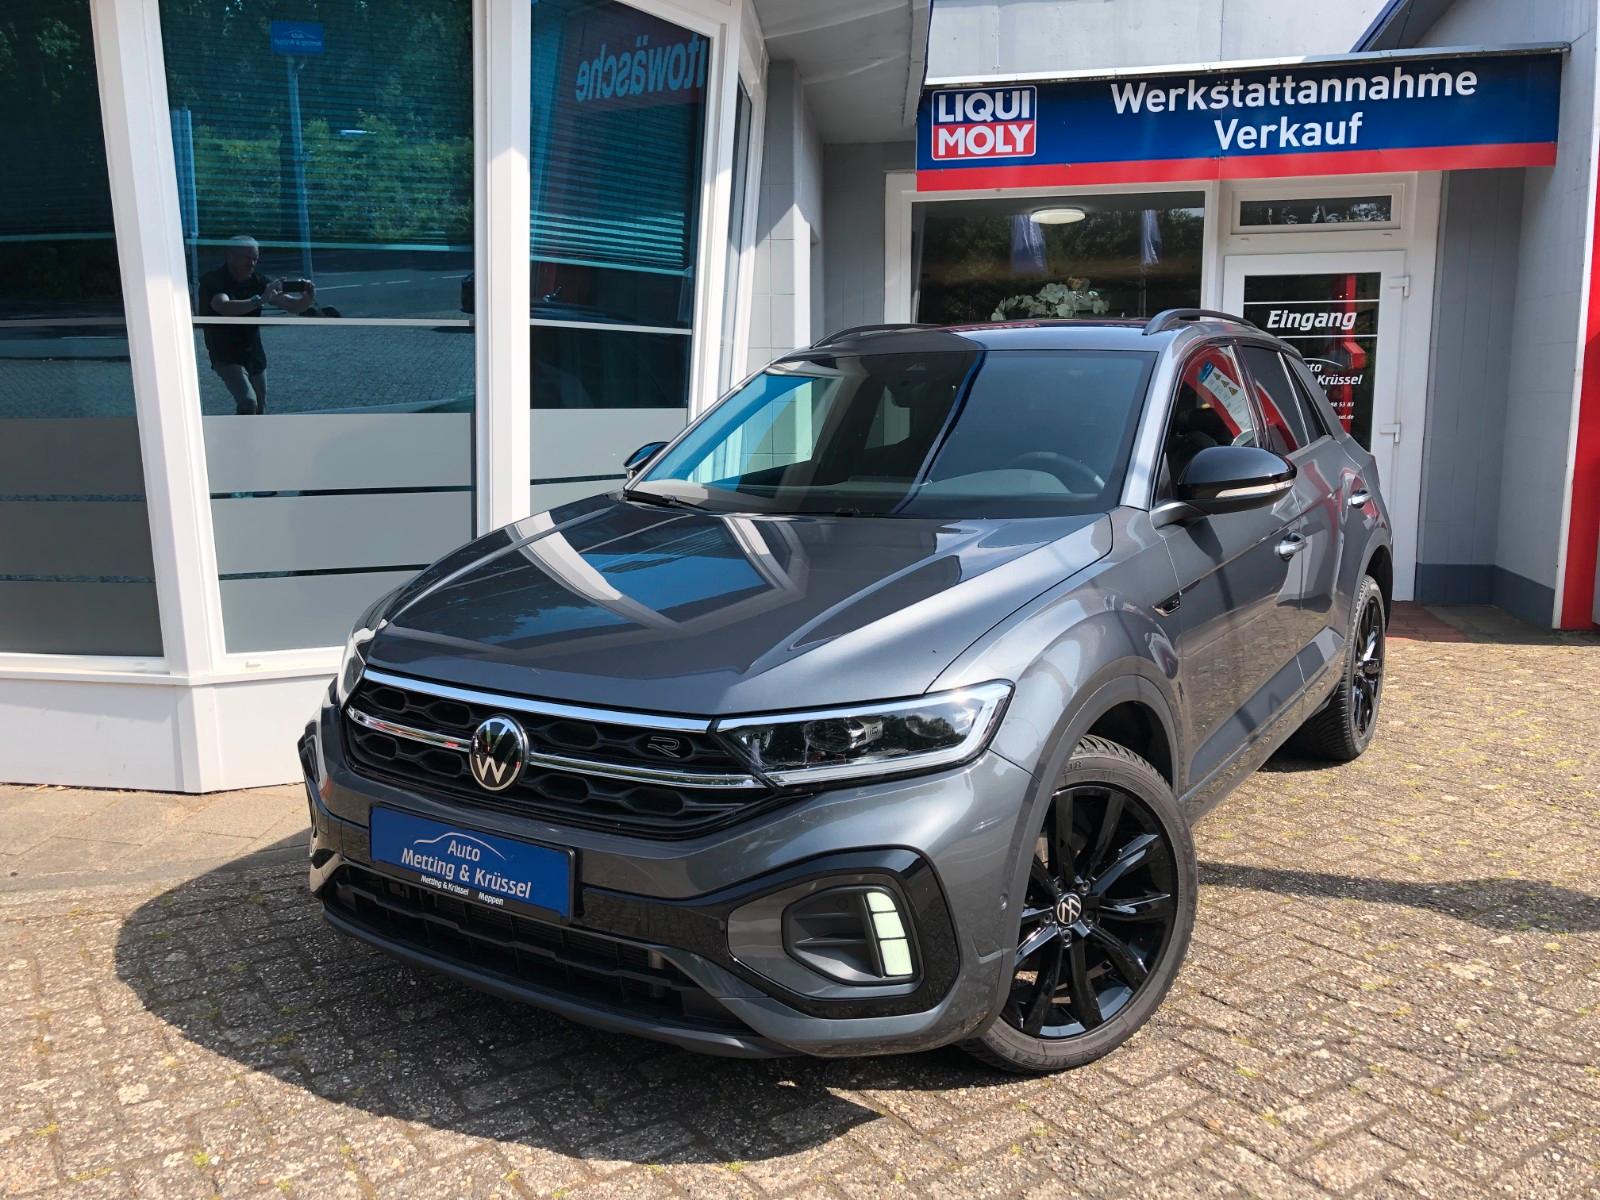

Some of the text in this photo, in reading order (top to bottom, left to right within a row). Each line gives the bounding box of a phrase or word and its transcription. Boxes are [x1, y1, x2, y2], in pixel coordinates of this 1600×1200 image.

[1110, 66, 1478, 114] Werkstattannahme
[938, 90, 1030, 122] LIQUI
[938, 124, 1033, 156] MOLY
[1214, 112, 1363, 150] Verkauf
[1266, 310, 1357, 331] Eingang
[1307, 363, 1322, 372] to
[1317, 374, 1363, 385] Krüssel
[447, 840, 480, 862] Auto
[401, 847, 532, 899] Metting & Krüssel
[478, 891, 504, 906] Meppen
